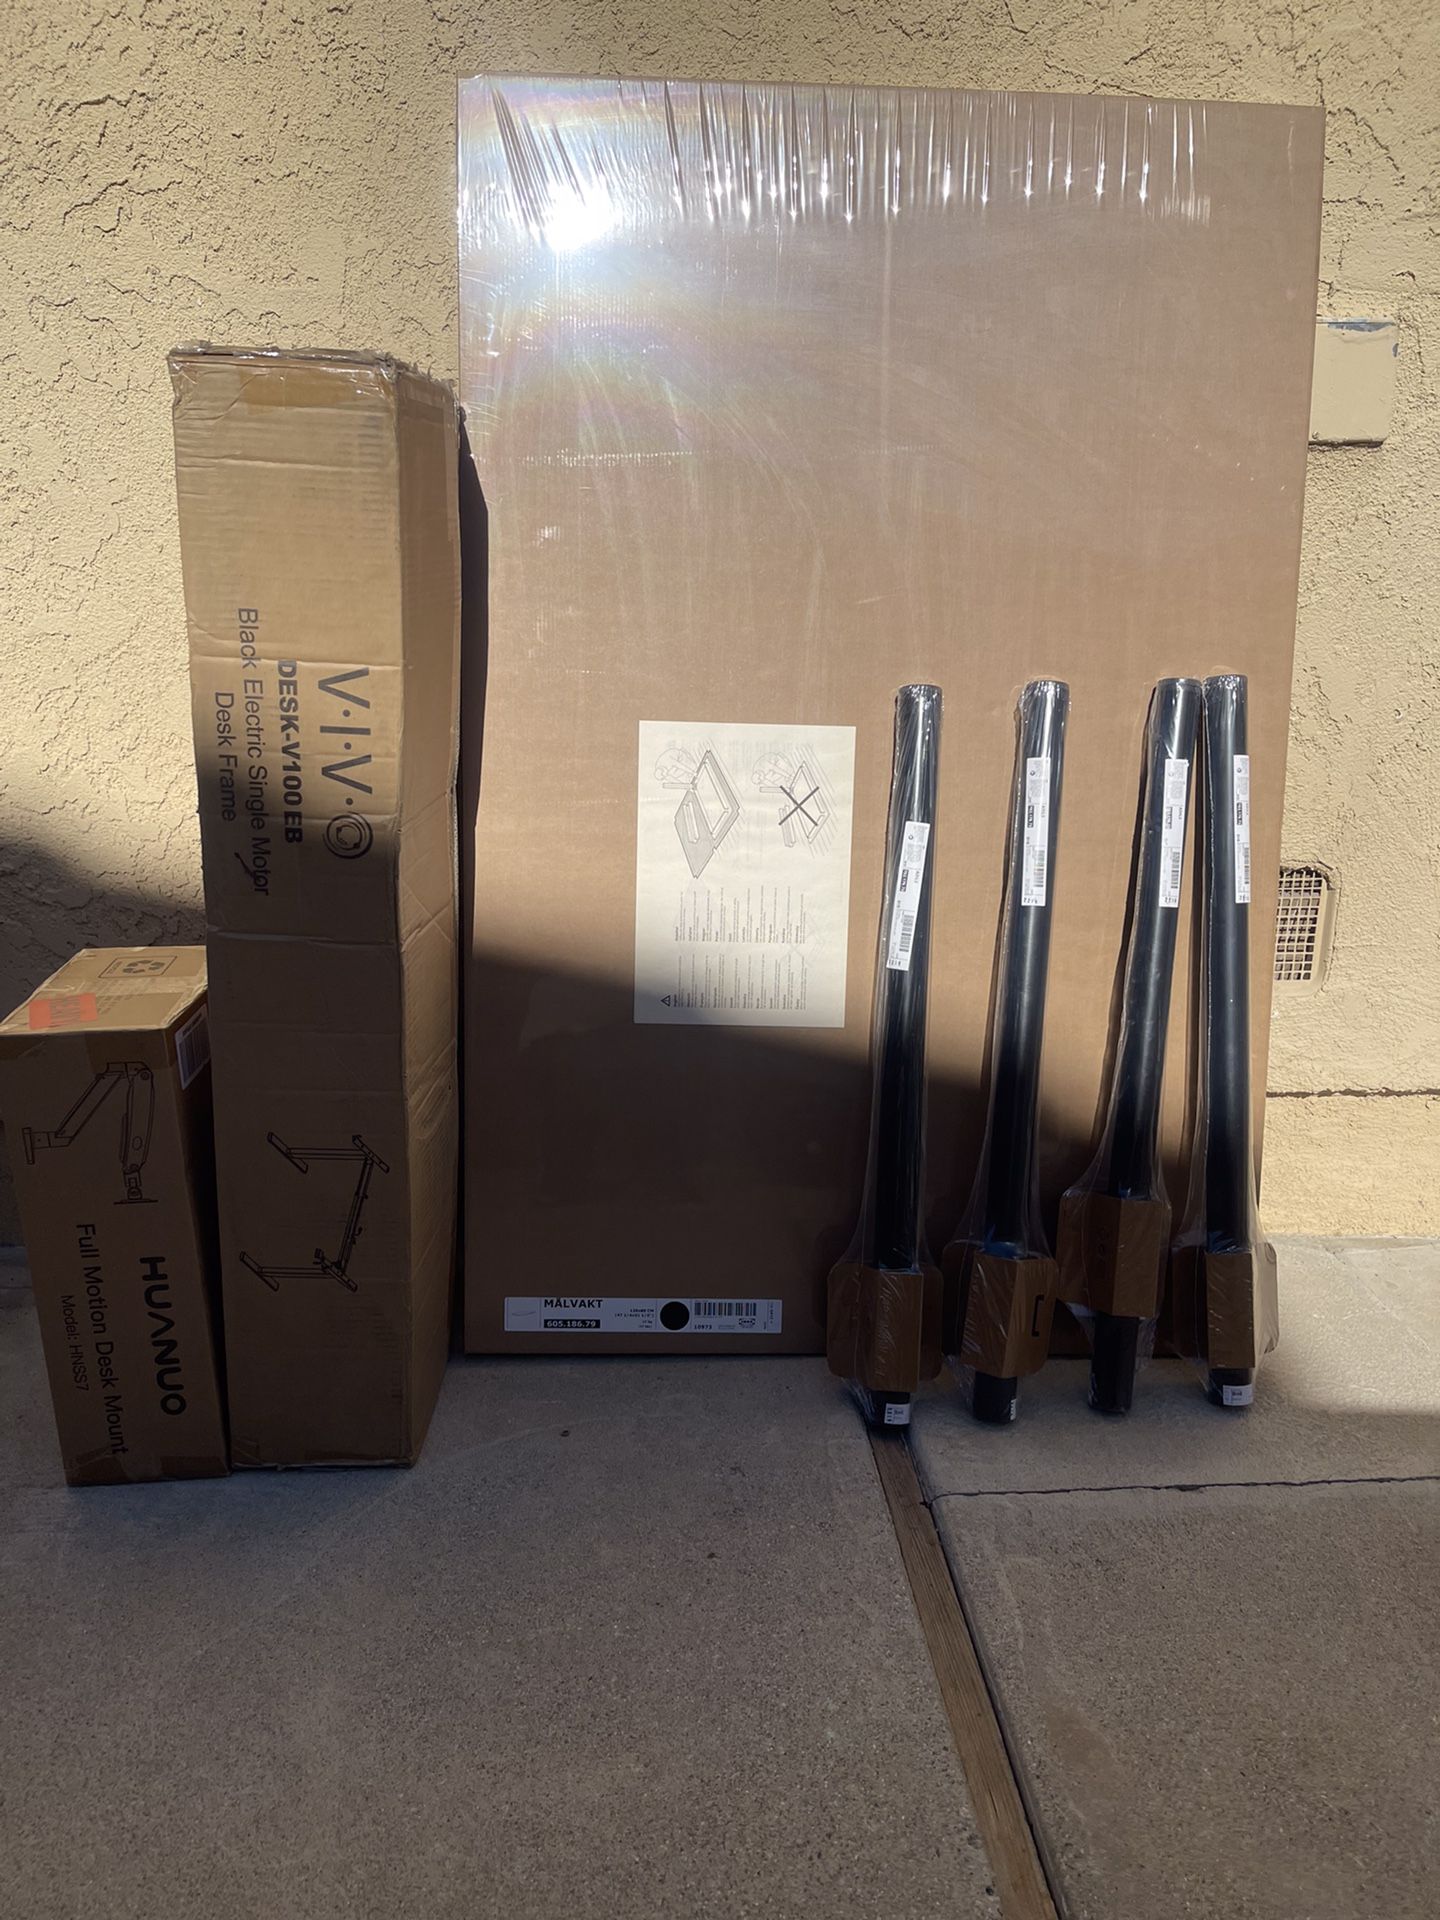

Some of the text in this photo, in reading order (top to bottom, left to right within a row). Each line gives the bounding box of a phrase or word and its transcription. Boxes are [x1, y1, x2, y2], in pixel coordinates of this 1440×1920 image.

[215, 692, 238, 822] Desk Frame
[238, 608, 270, 896] Black Electric Single Motor
[61, 1295, 88, 1391] Model: HNSS7
[76, 1223, 129, 1455] Full Motion Desk Mount
[140, 1256, 187, 1416] HUANUO
[544, 1298, 603, 1308] MÅLVAKT
[546, 1320, 597, 1328] 605.186.79
